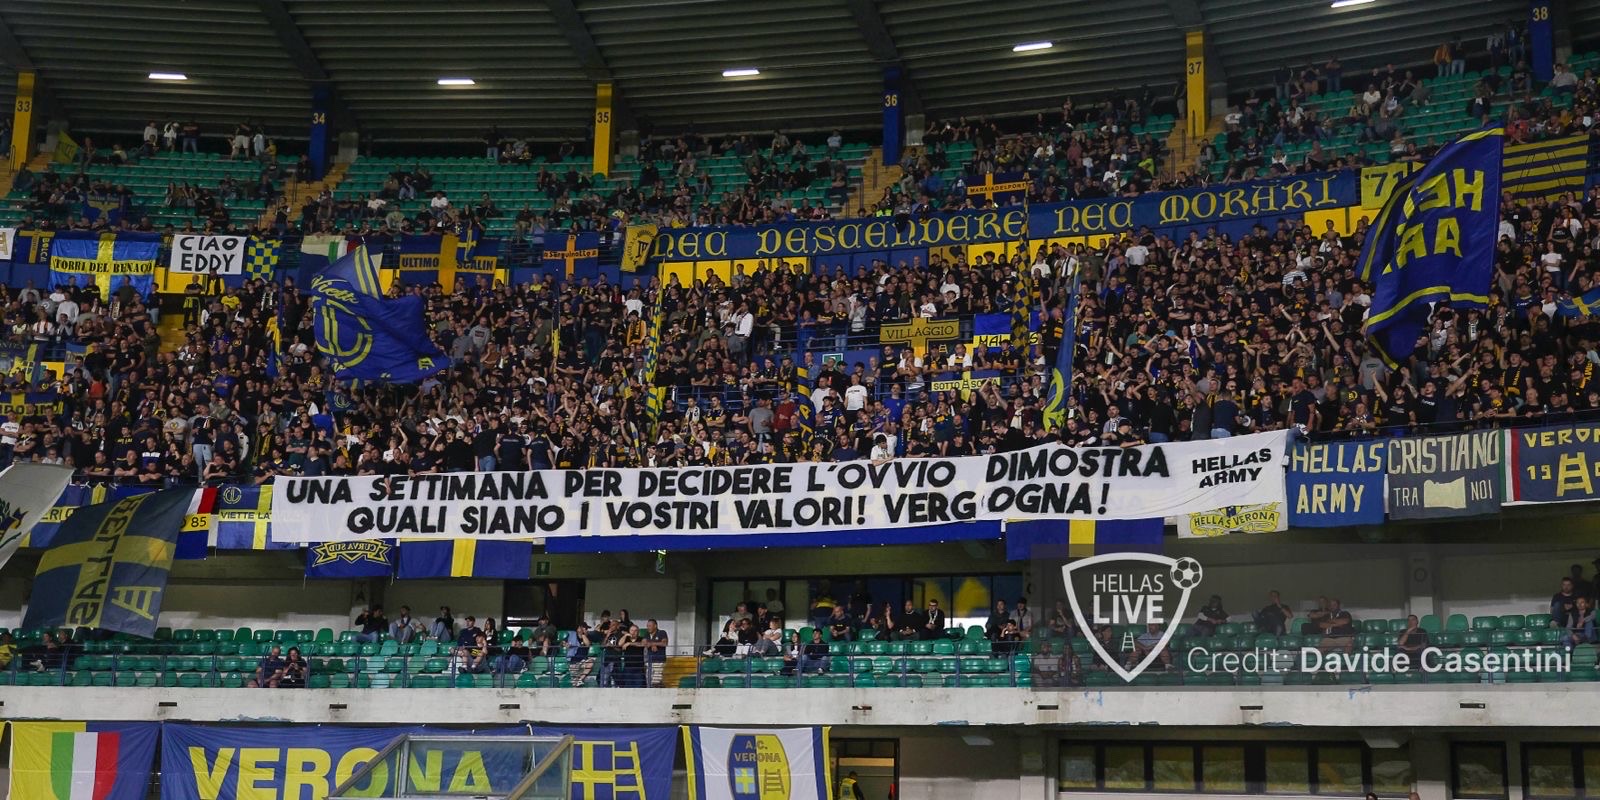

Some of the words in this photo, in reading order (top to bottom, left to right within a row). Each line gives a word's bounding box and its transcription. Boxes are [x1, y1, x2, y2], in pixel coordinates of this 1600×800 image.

[1532, 6, 1548, 21] 38
[1188, 62, 1202, 75] 37
[16, 100, 31, 112] 33
[884, 94, 898, 107] 36
[312, 112, 326, 125] 34
[596, 111, 609, 124] 35
[653, 232, 728, 259] NEC
[1053, 201, 1134, 235] NEC
[1159, 174, 1338, 225] MORARI
[180, 236, 239, 251] CIAO
[53, 258, 86, 272] TORRI
[88, 261, 110, 273] DEL
[112, 261, 153, 273] BENACO
[180, 253, 236, 273] EDDY
[401, 257, 440, 268] ULTIMO
[886, 325, 954, 340] VILLAGGIO
[933, 381, 960, 391] SOTTO
[1291, 443, 1384, 474] HELLAS
[1387, 429, 1500, 475] CRISTIANO
[1192, 448, 1272, 475] HELLAS
[287, 478, 353, 505] UNA
[369, 472, 548, 502] SETTIMANA
[564, 470, 623, 498] PER
[637, 465, 793, 499] DECIDERE
[985, 446, 1170, 483] DIMOSTRA
[1199, 466, 1263, 489] ARMY
[1296, 482, 1365, 515] ARMY
[1393, 486, 1420, 508] TRA
[1470, 478, 1493, 502] NOI
[190, 516, 207, 528] 85
[220, 511, 255, 520] VIETTE
[347, 504, 447, 534] QUALI
[460, 504, 566, 534] SIANO
[580, 501, 590, 530] I
[606, 500, 719, 530] VOSTRI
[735, 495, 867, 529] VALORI!
[1194, 516, 1231, 530] HELLAS
[1232, 511, 1275, 526] VERONA
[745, 739, 768, 750] A.C.
[734, 752, 782, 763] VERONA
[188, 746, 493, 800] VERONA
